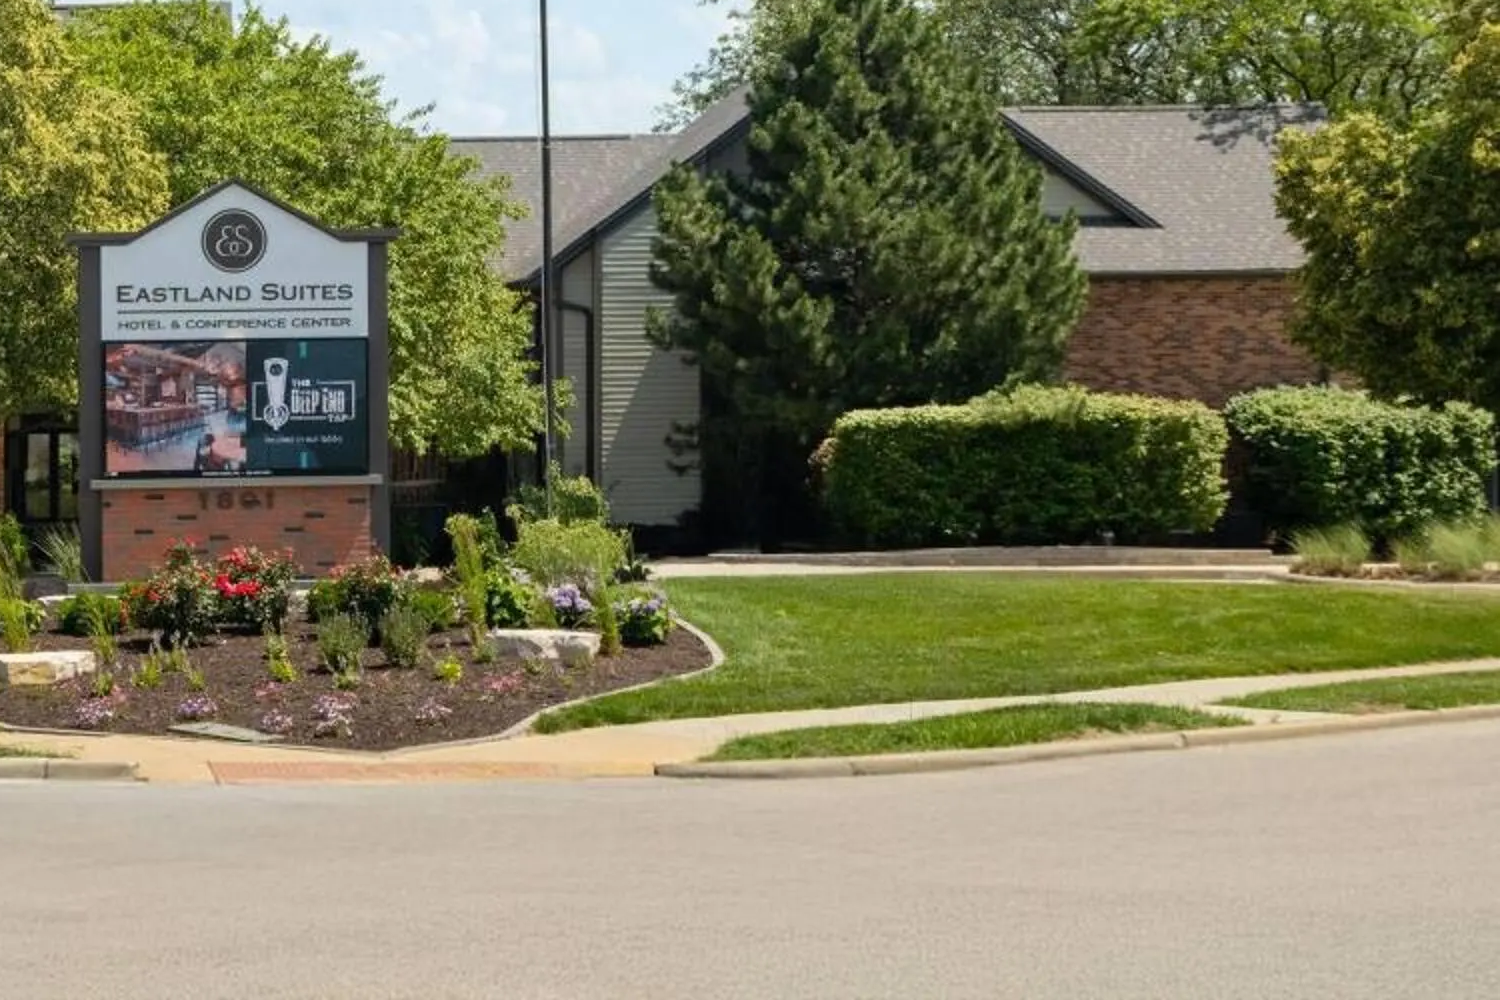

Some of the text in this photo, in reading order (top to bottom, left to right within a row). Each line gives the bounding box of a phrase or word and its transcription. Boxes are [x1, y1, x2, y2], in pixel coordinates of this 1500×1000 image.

[116, 283, 354, 304] EASTLAND SUITES
[117, 316, 352, 331] HOTEL & CONFERENCE CENTER
[322, 388, 345, 413] END
[328, 414, 348, 423] TAP
